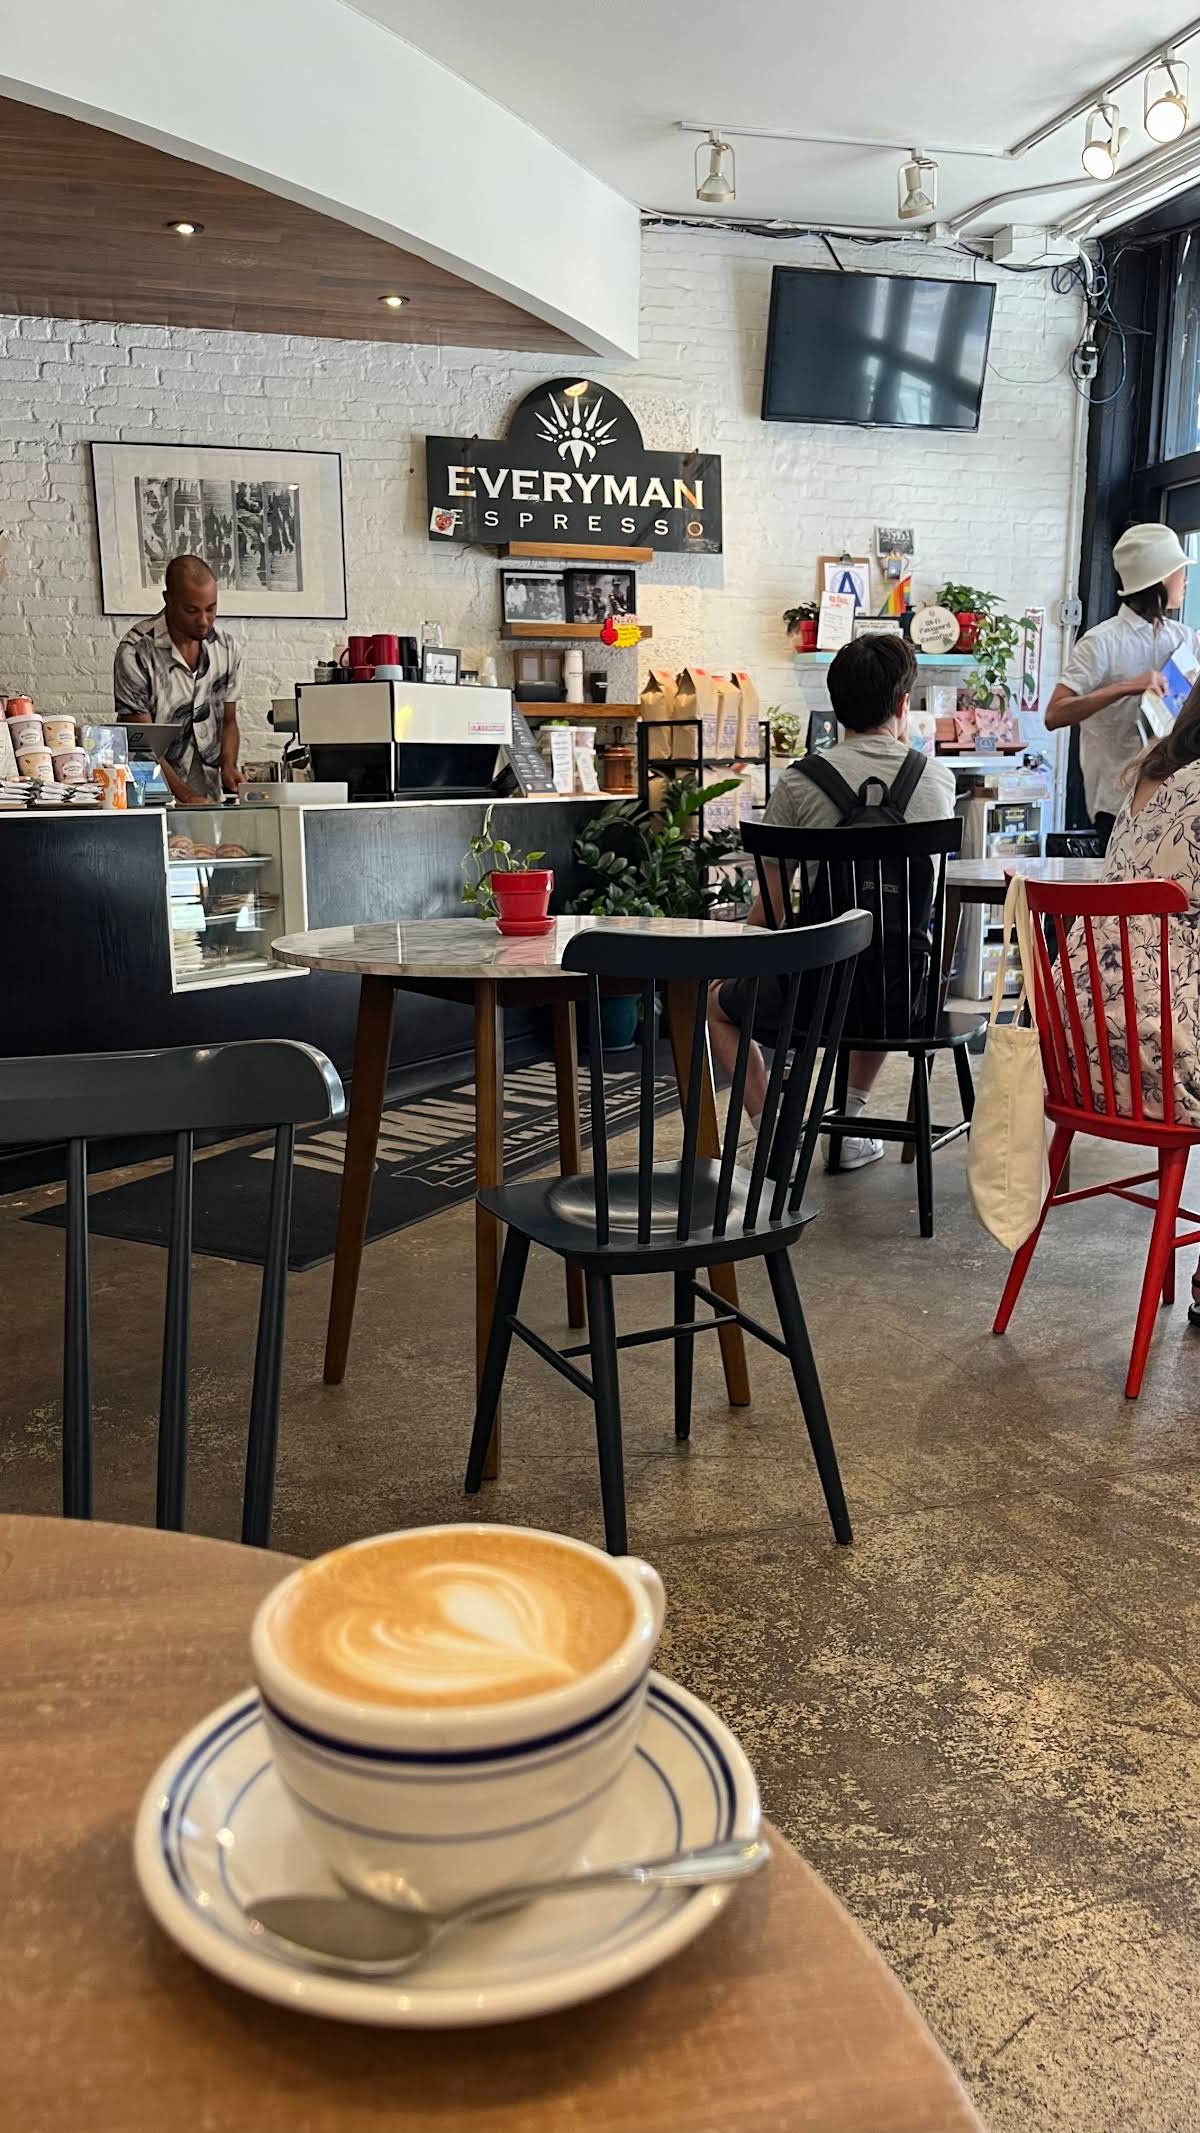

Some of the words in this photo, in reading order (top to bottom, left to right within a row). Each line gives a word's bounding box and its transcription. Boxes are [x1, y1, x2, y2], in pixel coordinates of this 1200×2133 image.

[448, 465, 704, 510] EVERYMAN
[450, 508, 704, 538] ESPRESSO
[838, 571, 862, 607] A
